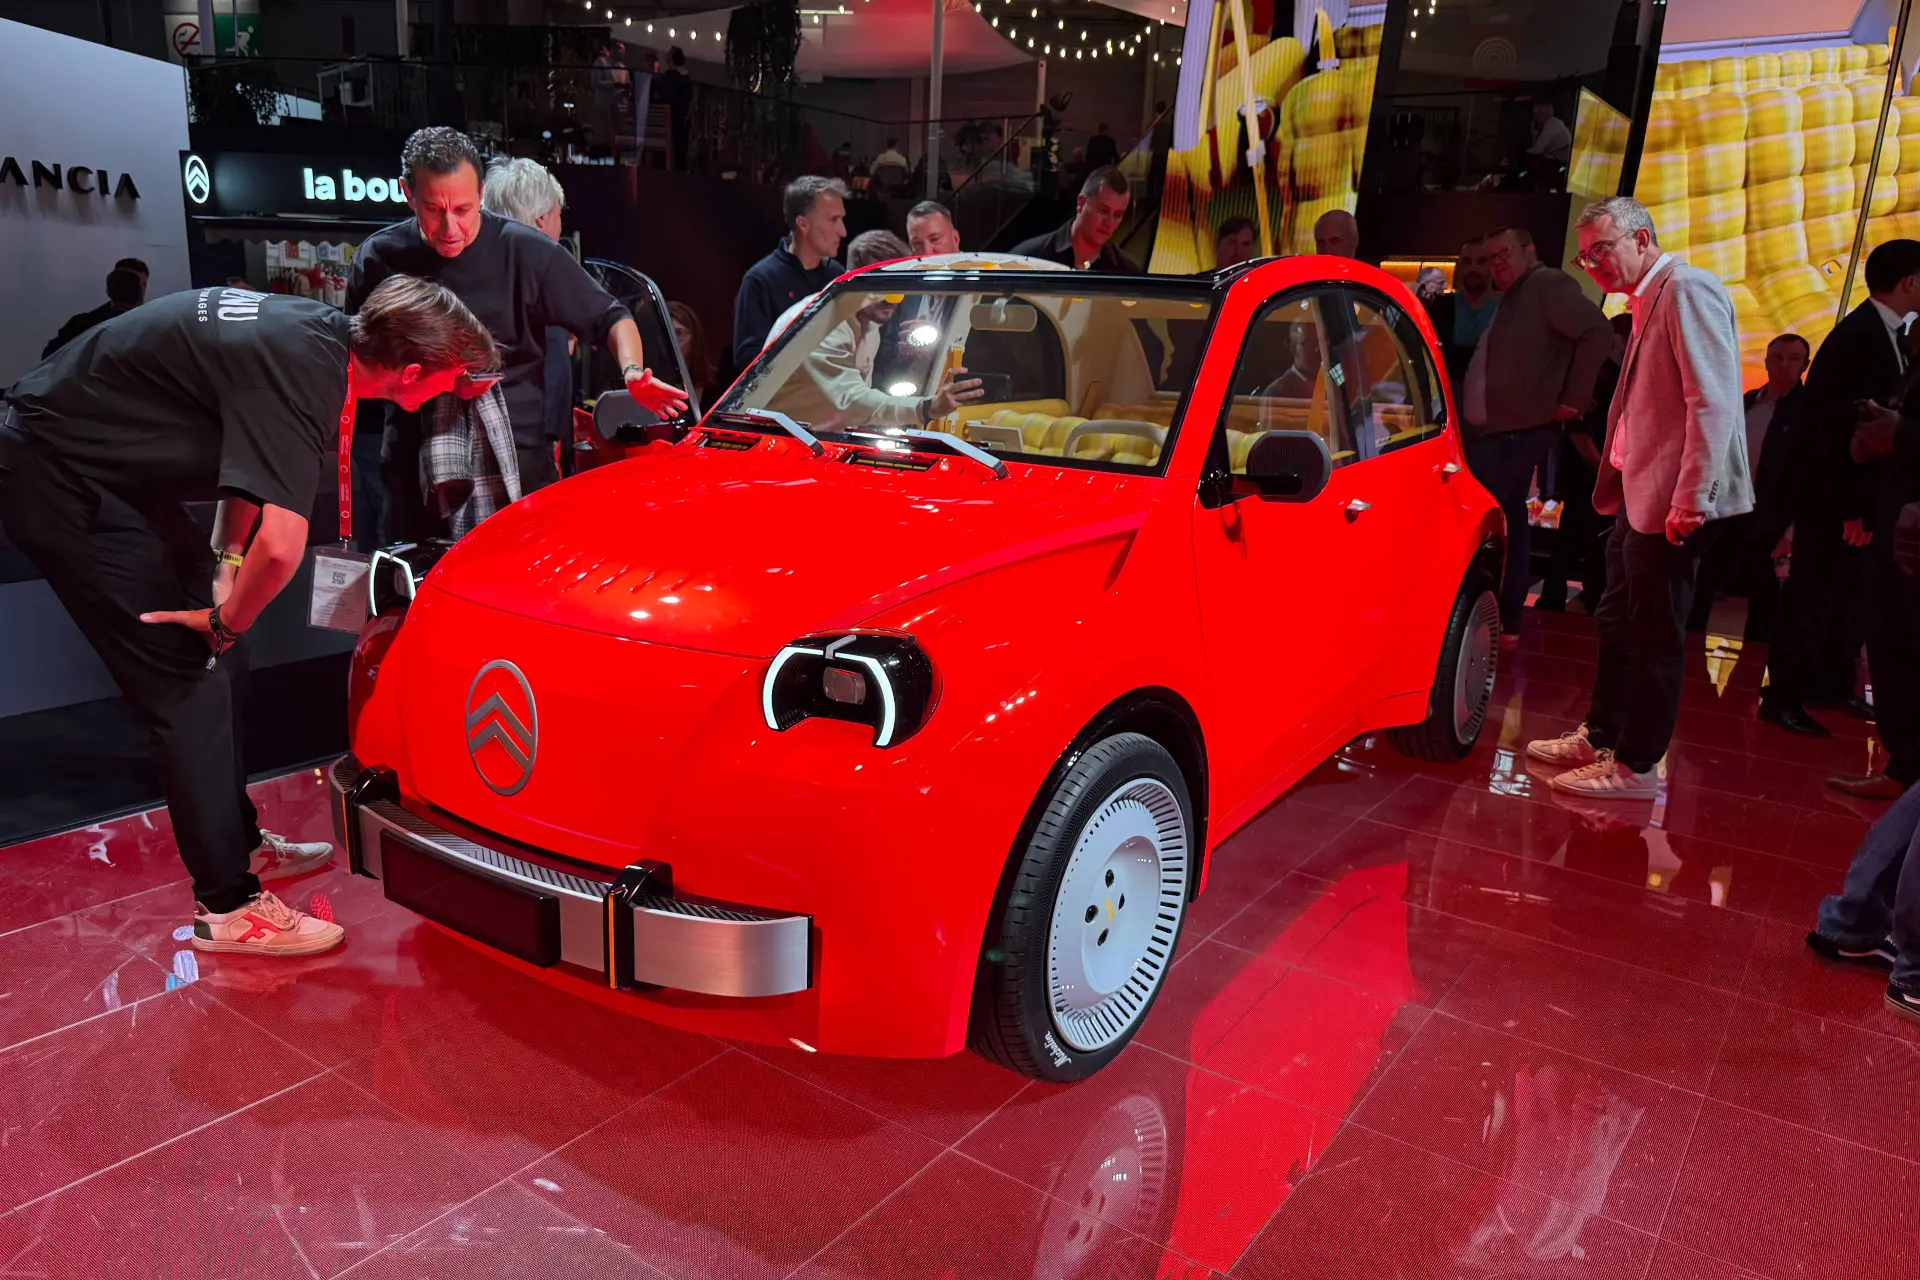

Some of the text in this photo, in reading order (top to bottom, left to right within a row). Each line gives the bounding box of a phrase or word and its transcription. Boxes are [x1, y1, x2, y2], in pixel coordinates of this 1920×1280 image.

[0, 156, 141, 199] ANCIA
[303, 167, 336, 200] la
[1044, 1030, 1072, 1068] Michelin
